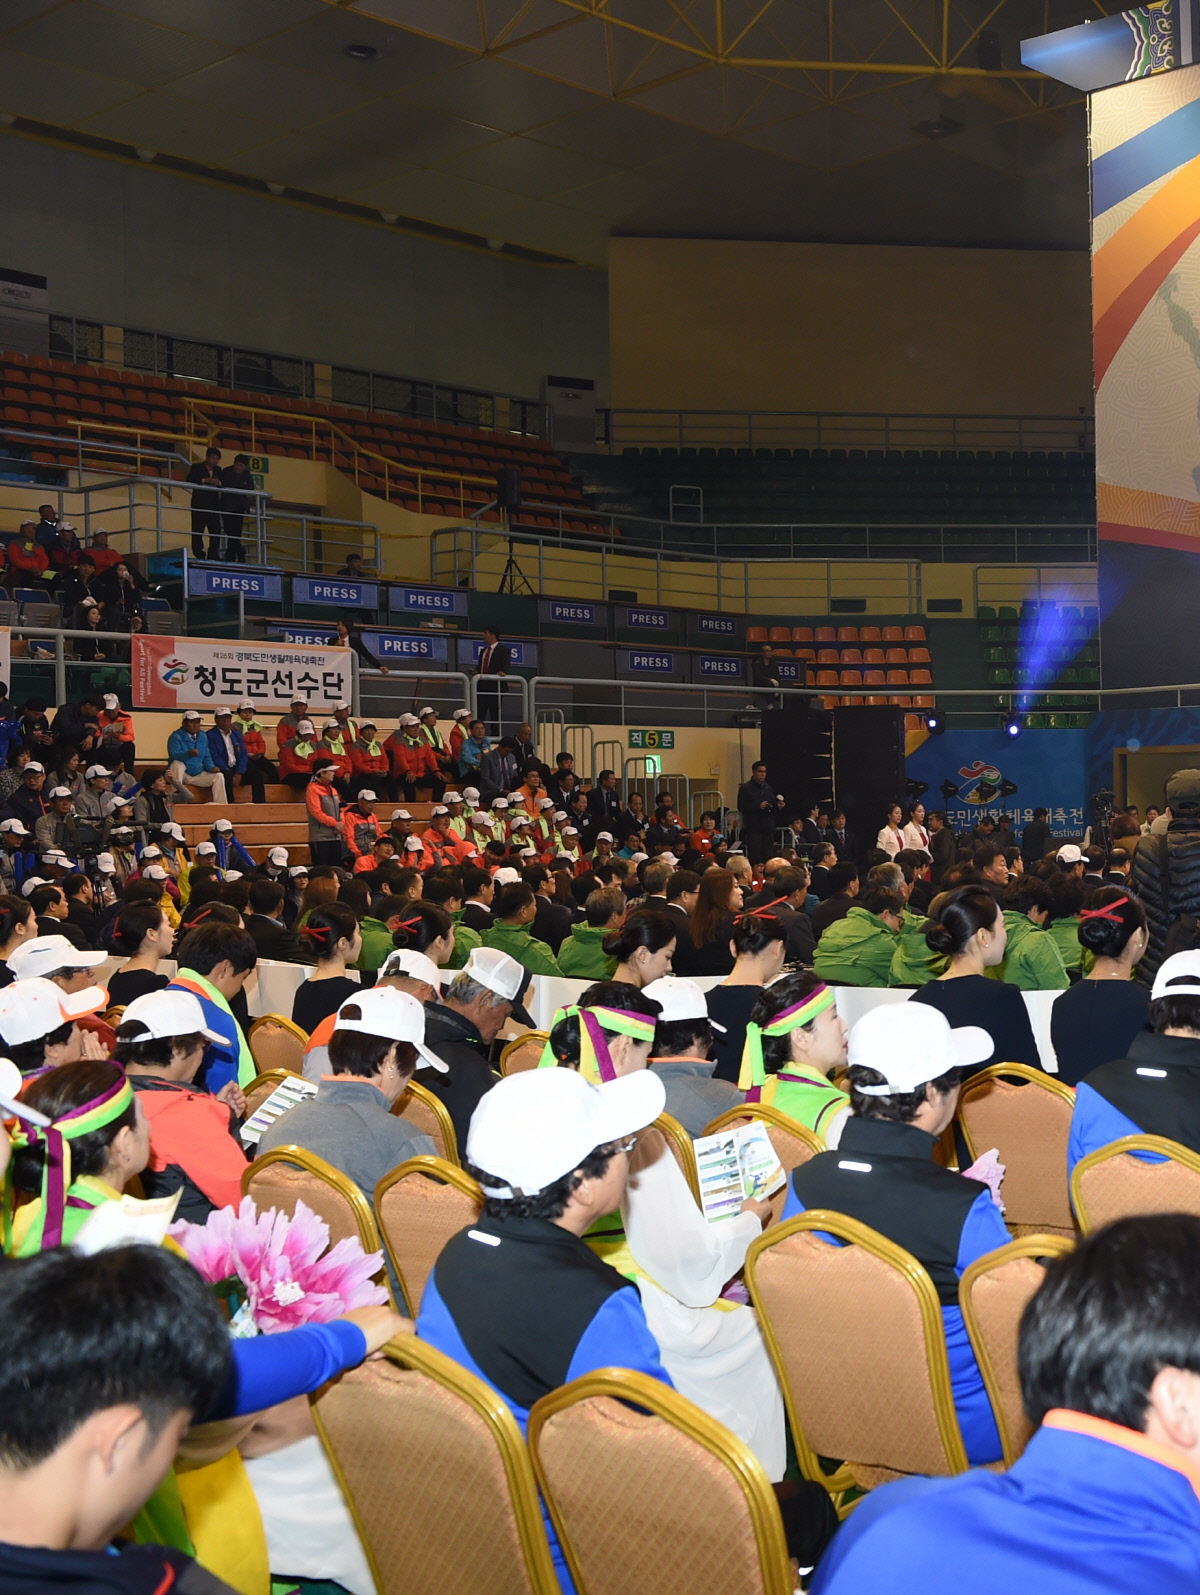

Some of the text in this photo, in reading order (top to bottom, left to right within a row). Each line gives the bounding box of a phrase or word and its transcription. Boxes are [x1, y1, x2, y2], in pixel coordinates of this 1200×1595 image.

[251, 458, 260, 470] 8
[212, 576, 260, 591] PRESS
[313, 585, 358, 600] PRESS
[409, 594, 450, 608] PRESS
[555, 607, 591, 619] PRESS
[631, 613, 665, 626] PRESS
[702, 620, 733, 631] PRESS
[384, 639, 428, 654] PRESS
[235, 651, 325, 667] 경북도민생활체육대축전
[633, 656, 669, 668] PRESS
[704, 662, 737, 673] PRESS
[193, 664, 345, 700] 청도군선수단
